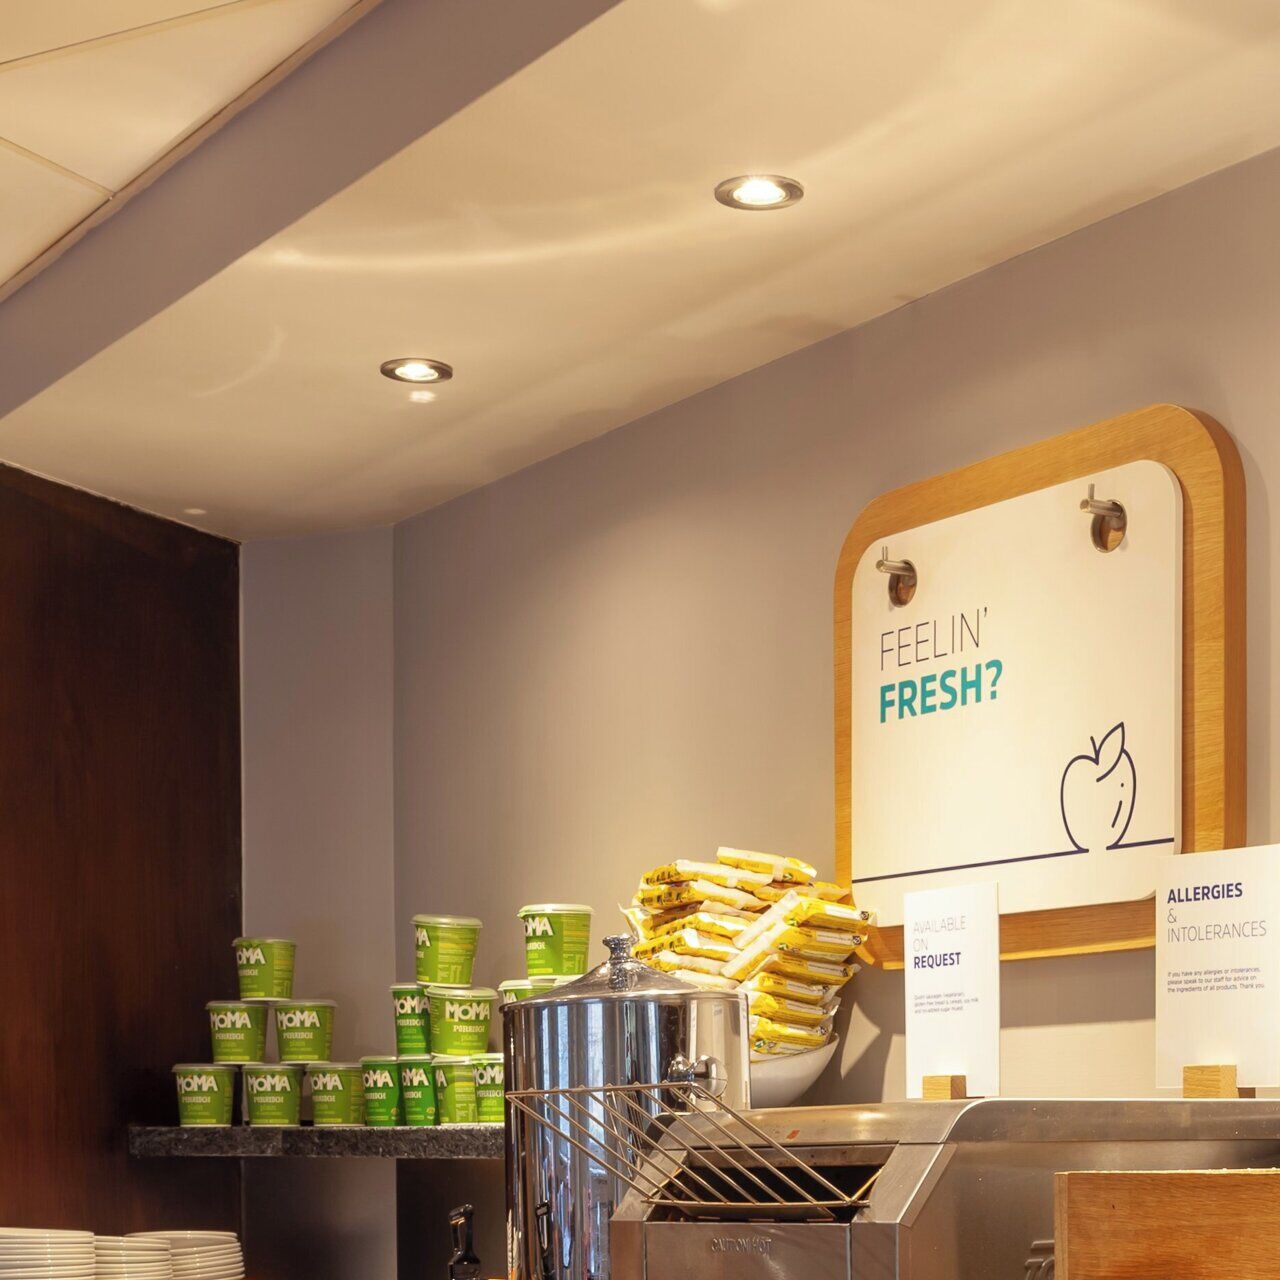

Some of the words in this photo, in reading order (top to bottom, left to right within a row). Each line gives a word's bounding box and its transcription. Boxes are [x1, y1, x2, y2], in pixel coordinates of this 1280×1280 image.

[880, 606, 988, 671] FEELIN'
[879, 659, 1003, 723] FRESH?
[1167, 882, 1243, 904] ALLERGIES
[913, 915, 967, 934] AVAILABLE
[1167, 908, 1177, 924] &
[1167, 920, 1267, 944] INTOLERANCES
[913, 952, 962, 969] REQUEST
